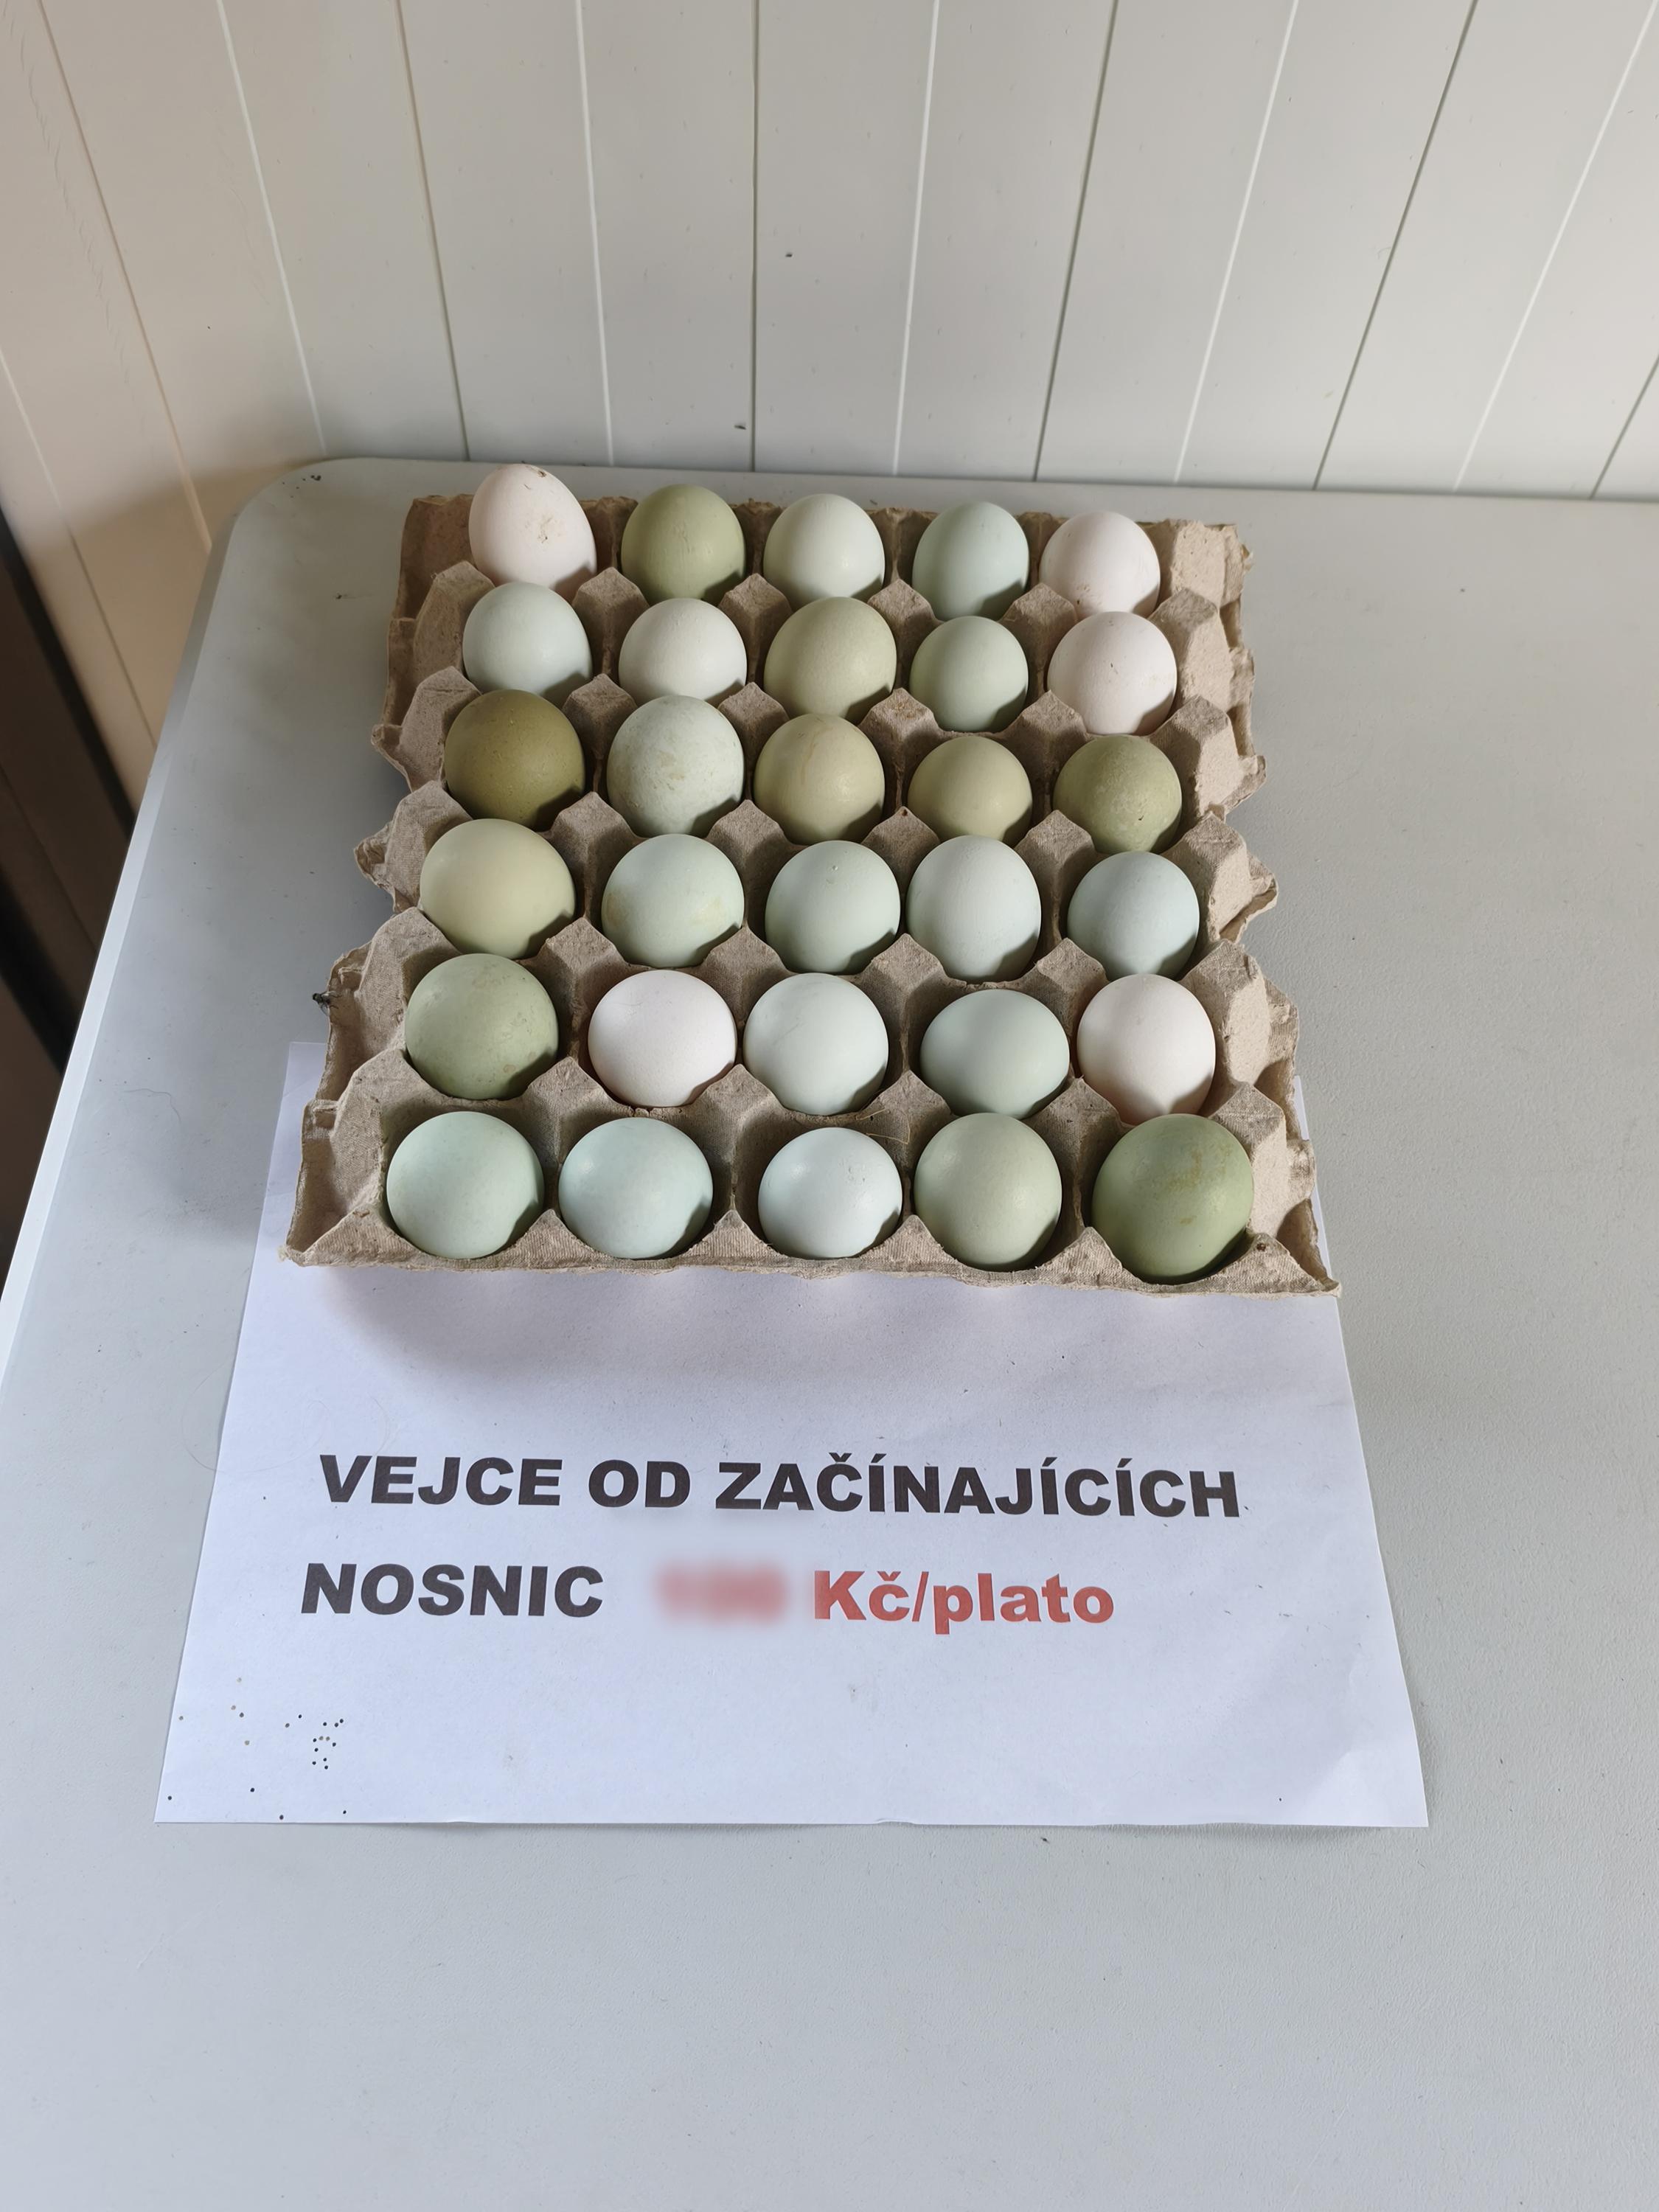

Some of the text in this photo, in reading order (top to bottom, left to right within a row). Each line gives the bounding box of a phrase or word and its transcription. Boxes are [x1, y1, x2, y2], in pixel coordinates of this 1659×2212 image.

[319, 1452, 1240, 1518] VEJCE OD ZAČÍNAJÍCÍCH
[301, 1562, 604, 1618] NOSNIC
[814, 1571, 1114, 1635] Kč/plato
